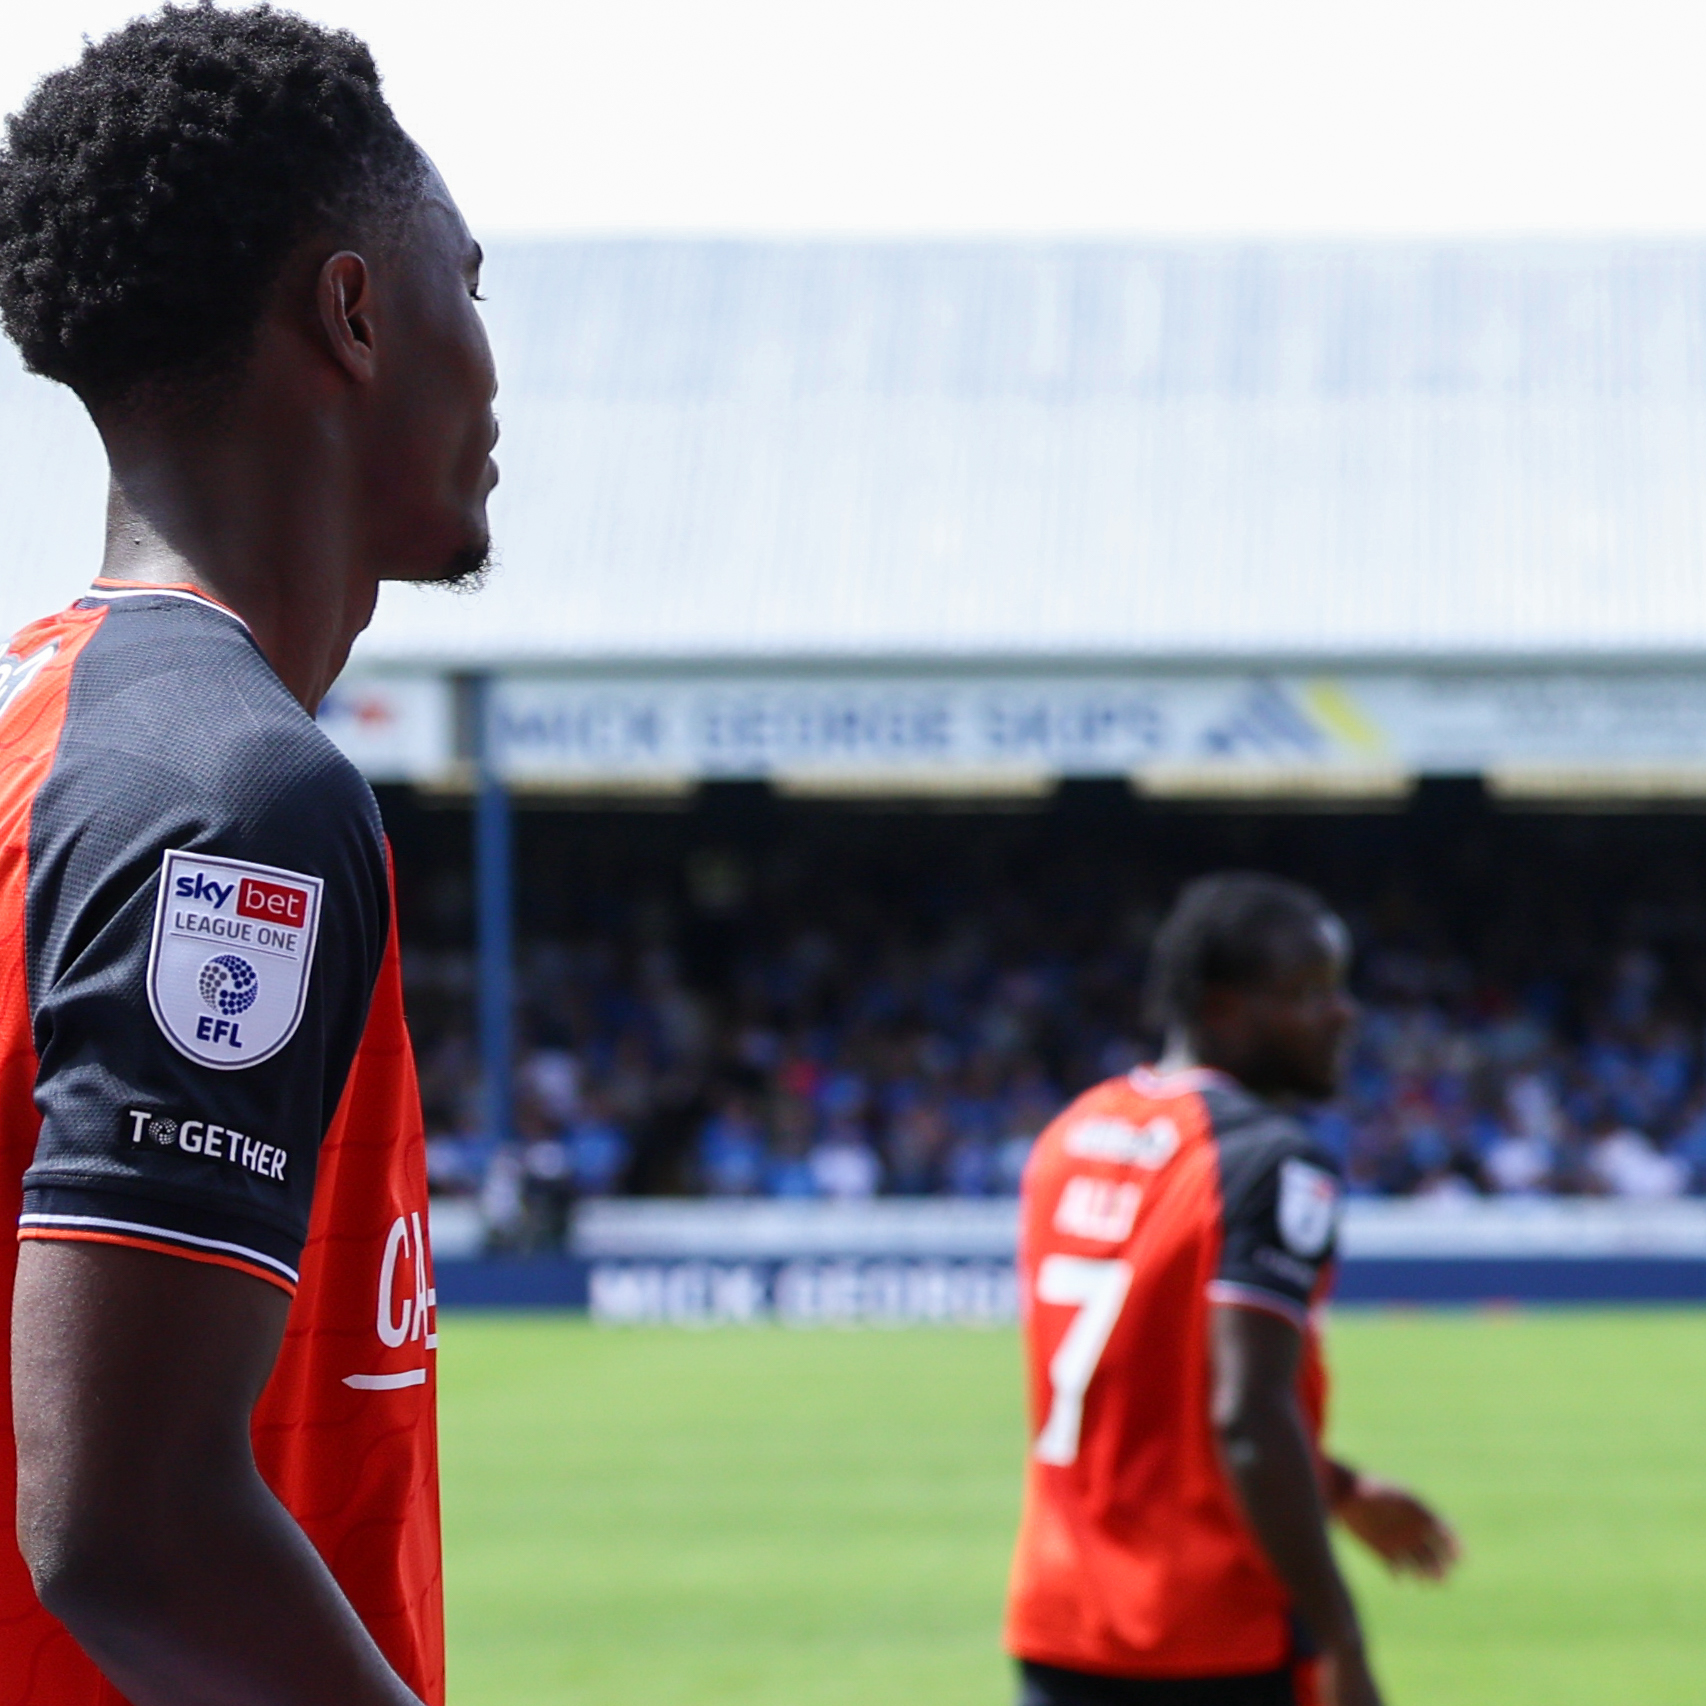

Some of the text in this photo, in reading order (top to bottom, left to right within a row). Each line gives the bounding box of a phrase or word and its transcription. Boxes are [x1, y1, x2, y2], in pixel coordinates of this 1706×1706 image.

[175, 872, 301, 918] sky bet
[175, 911, 298, 952] LEAGUE ONE
[196, 1015, 243, 1049] EFL
[1034, 1255, 1134, 1467] 7
